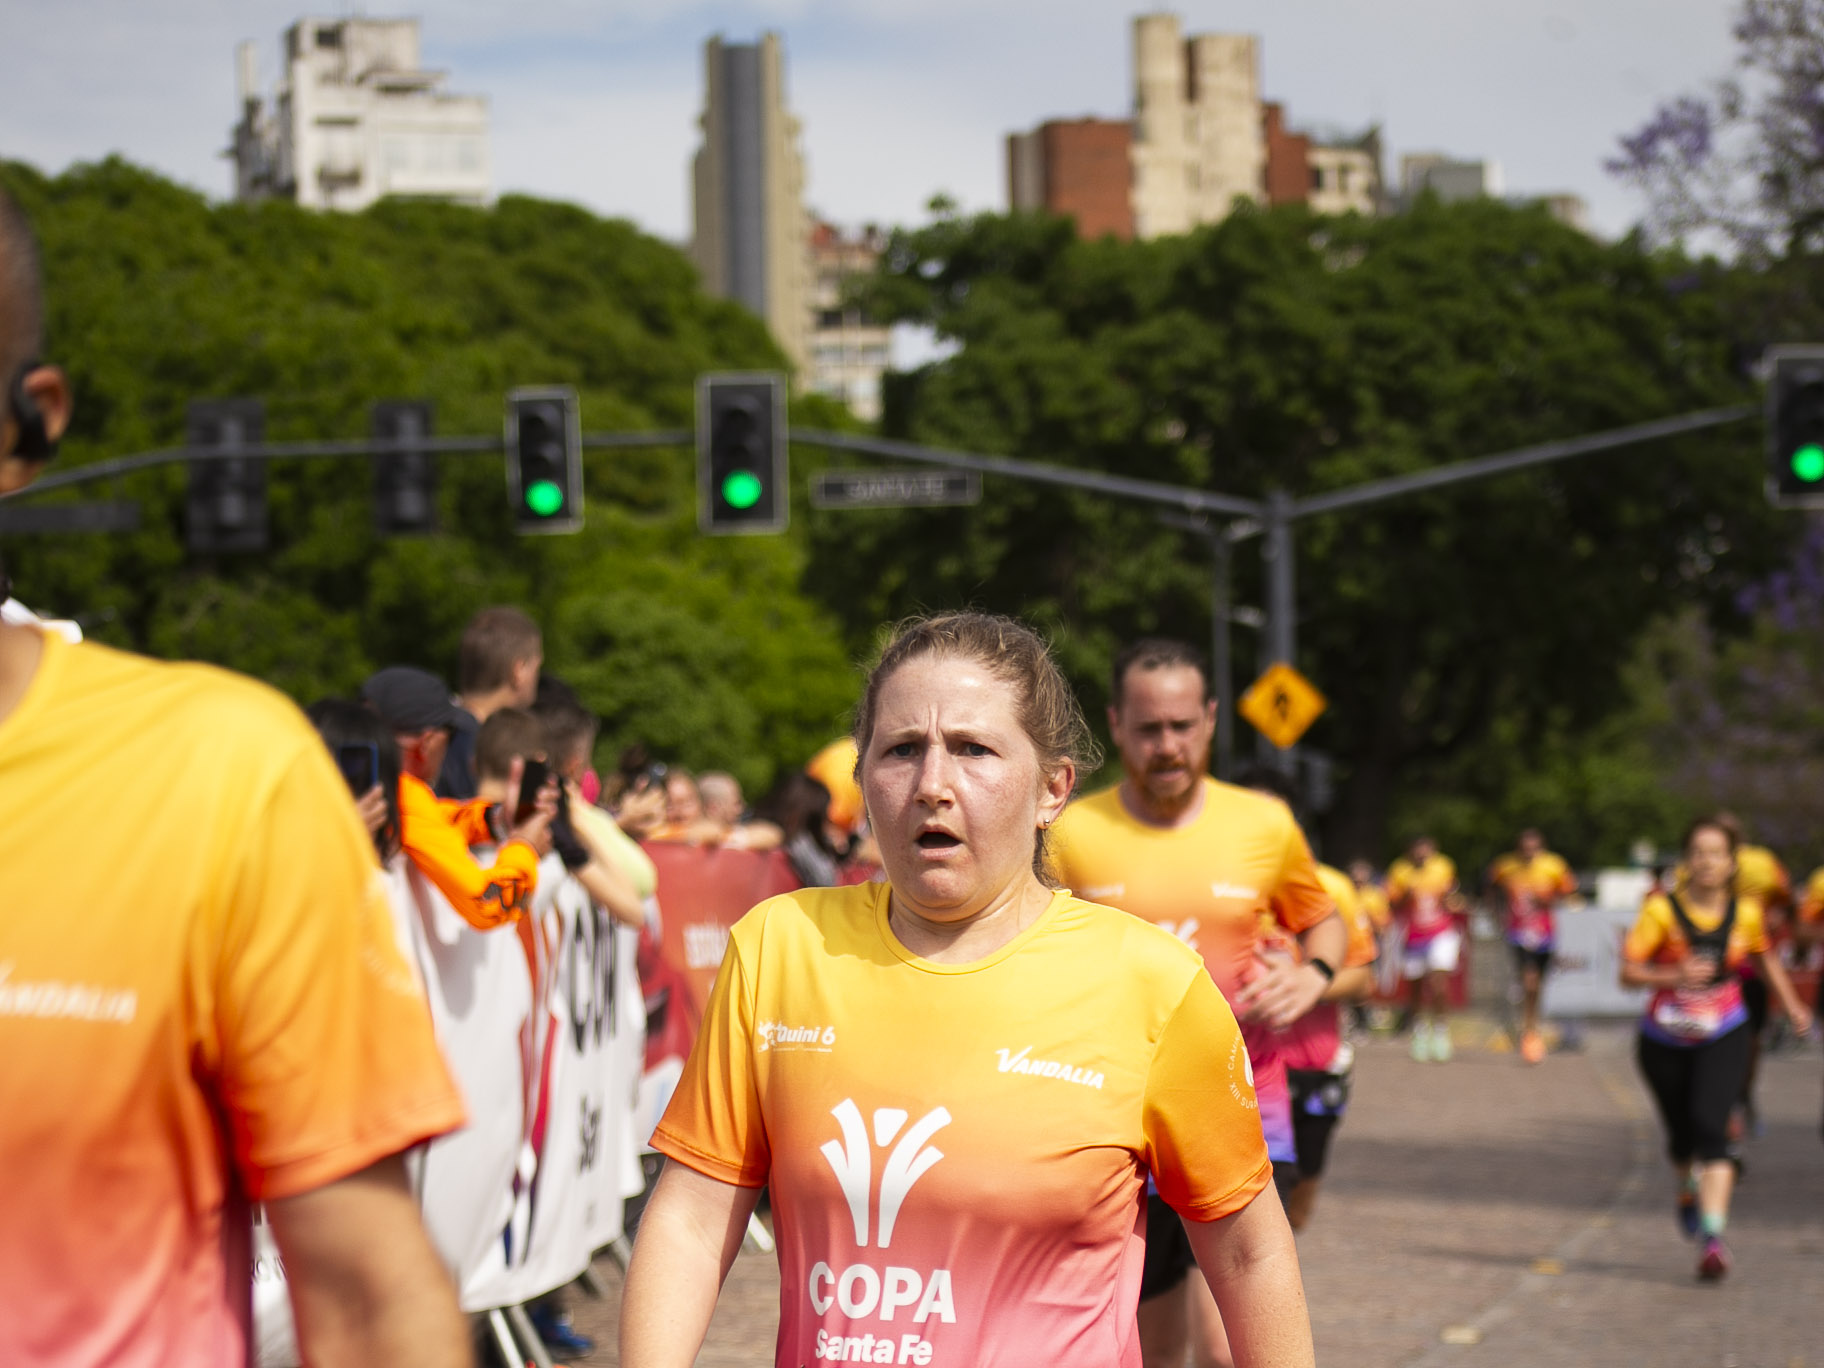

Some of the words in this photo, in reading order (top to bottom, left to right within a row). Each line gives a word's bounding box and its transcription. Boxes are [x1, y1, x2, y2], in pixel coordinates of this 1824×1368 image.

[777, 1024, 821, 1043] Quini
[821, 1026, 836, 1046] 6
[809, 1261, 957, 1324] COPA
[815, 1328, 896, 1364] Santa
[897, 1334, 934, 1366] Fe
